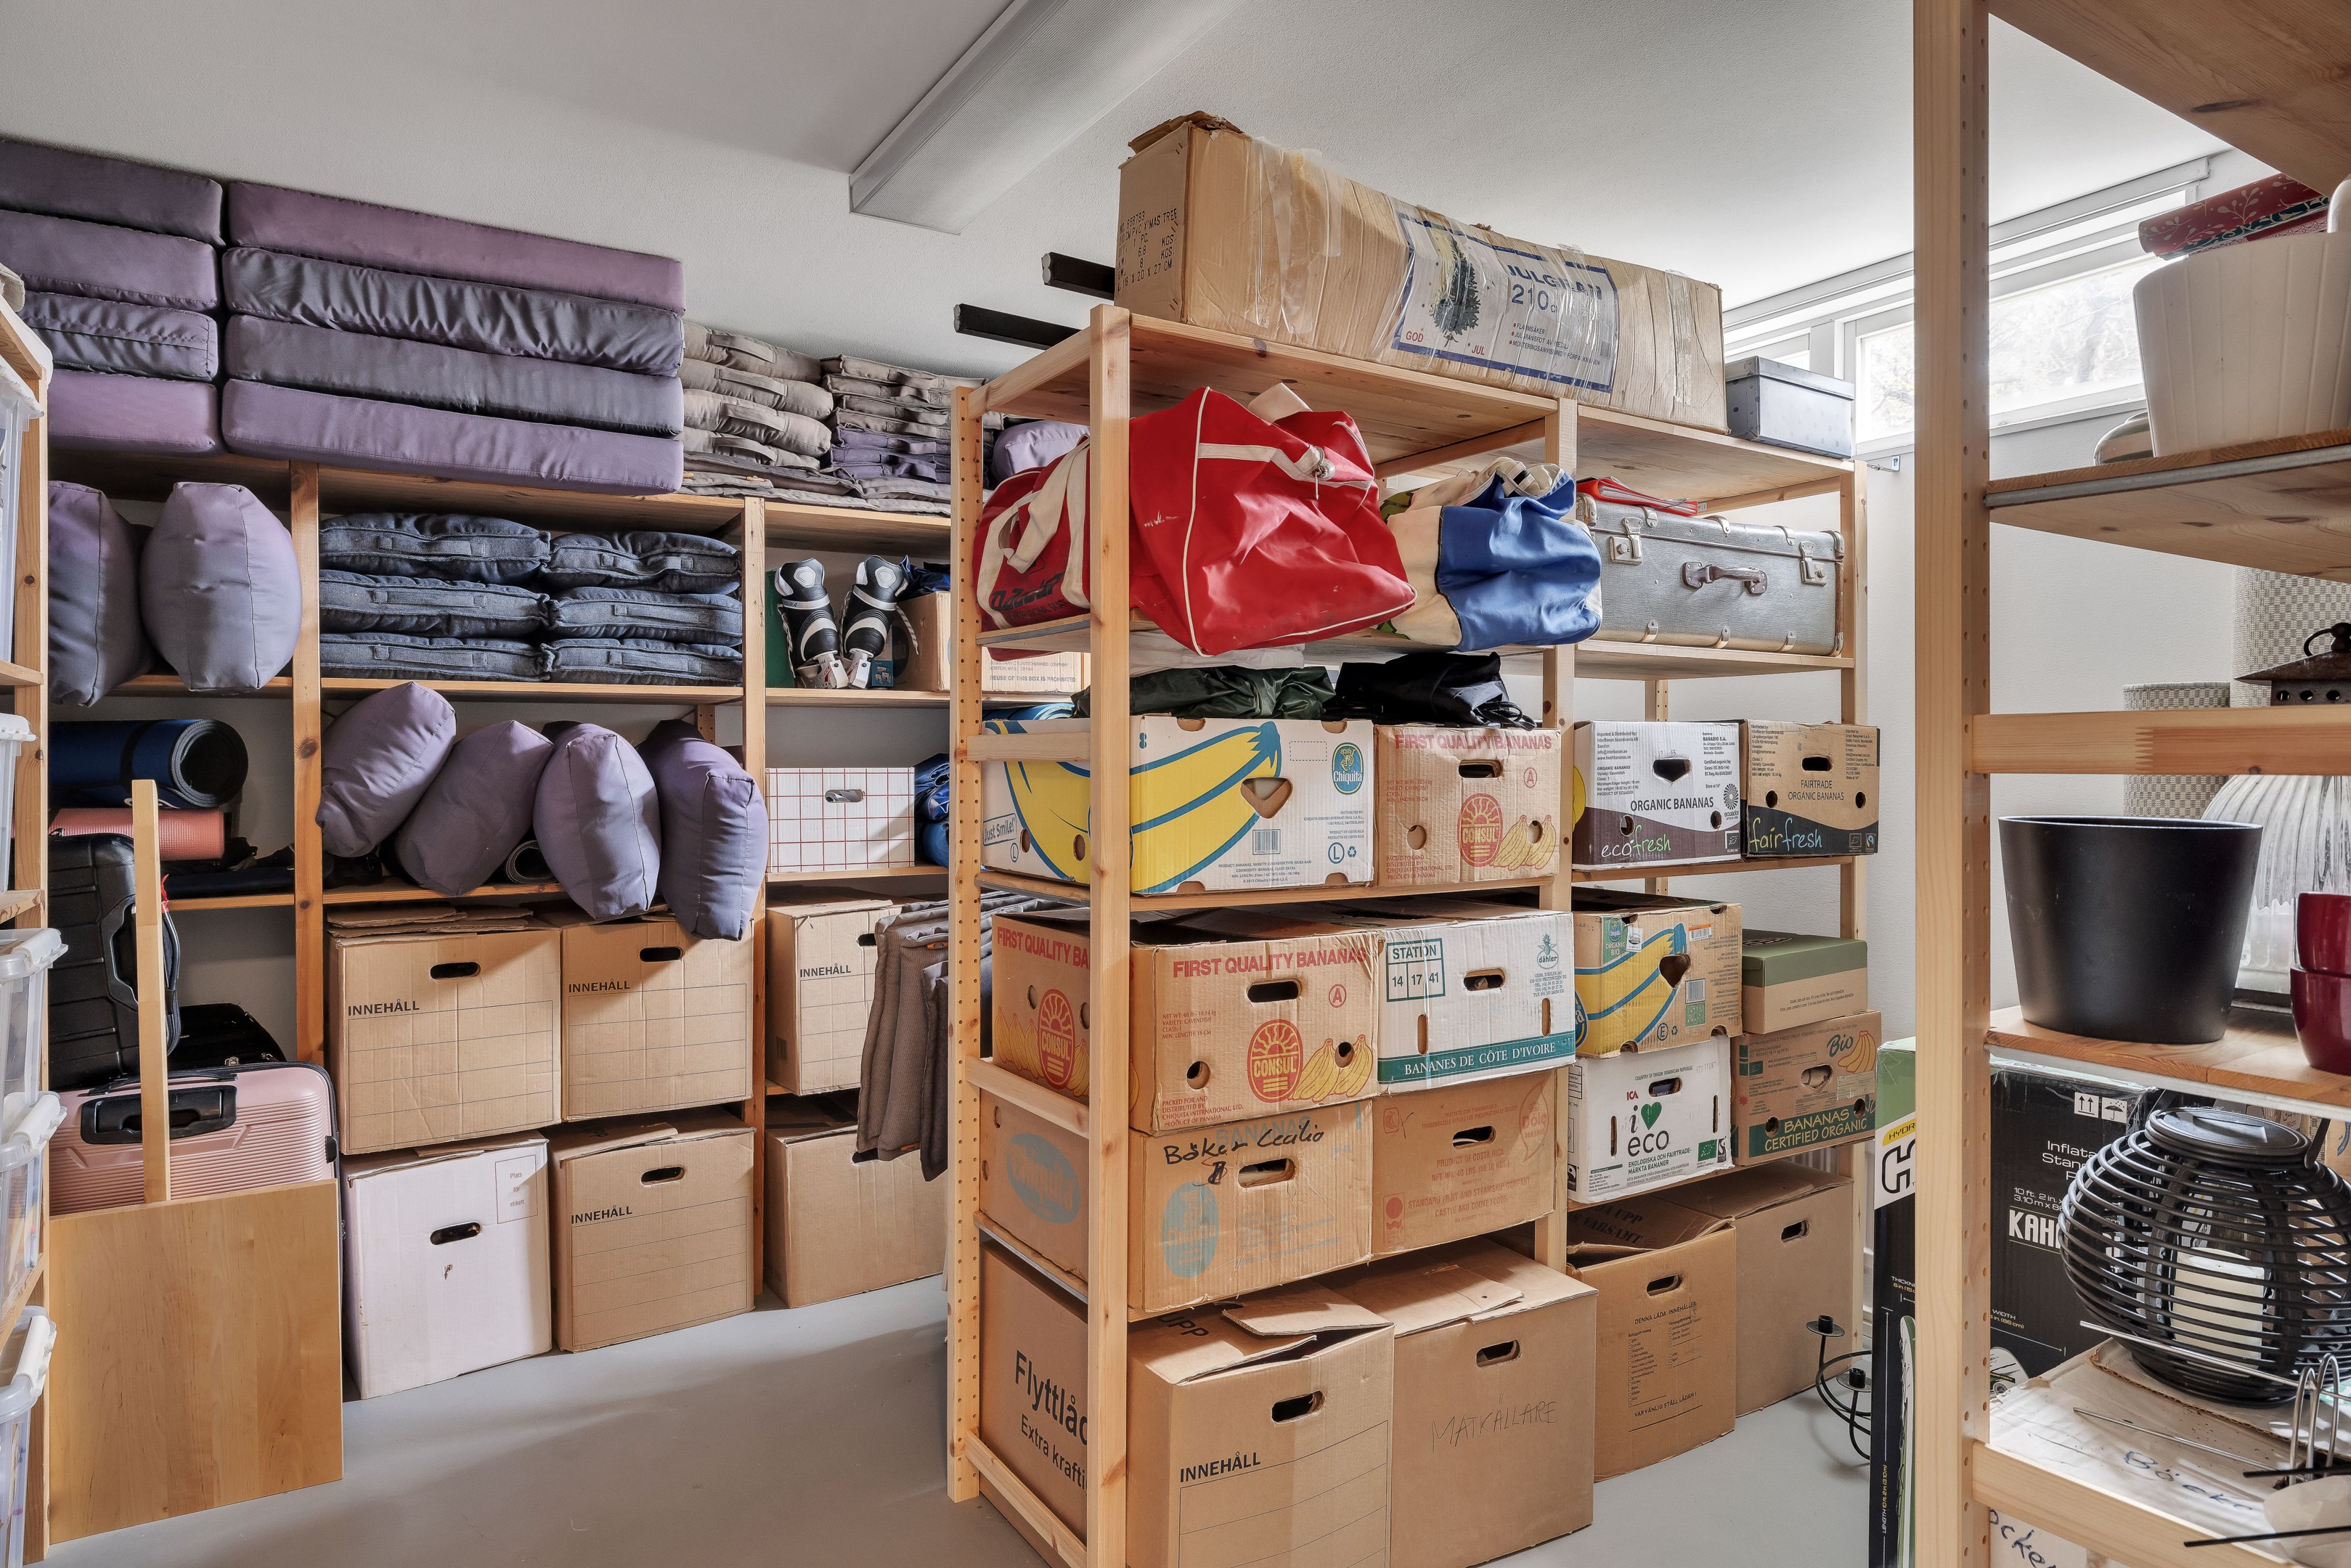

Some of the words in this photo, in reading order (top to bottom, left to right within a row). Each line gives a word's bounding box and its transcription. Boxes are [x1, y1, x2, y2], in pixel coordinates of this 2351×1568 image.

[1163, 208, 1178, 223] TREE
[1138, 270, 1144, 281] 20
[1154, 264, 1161, 274] 27
[1511, 284, 1549, 311] 210
[1406, 331, 1424, 343] GOD
[1472, 345, 1485, 356] JUL
[1395, 734, 1434, 749] FIRST
[1438, 734, 1491, 750] QUALITY
[1495, 735, 1552, 750] BANANAS
[1334, 770, 1362, 785] Chiquita
[1526, 769, 1535, 784] A
[1801, 780, 1833, 789] FAIRTRADE
[1631, 799, 1671, 812] ORGANIC
[1674, 796, 1714, 810] BANANAS
[1788, 791, 1815, 801] ORGANIC
[1817, 791, 1844, 801] BANANAS
[985, 825, 995, 842] Just
[1462, 827, 1498, 844] CONSUL
[997, 926, 1023, 951] FIRST
[1024, 934, 1071, 964] QUALITY
[1392, 944, 1437, 960] STATION
[800, 963, 852, 978] INNEHÅLL
[1173, 958, 1221, 978] FIRST
[1225, 952, 1292, 973] QUALITY
[1297, 947, 1366, 968] BANANAS
[569, 978, 631, 993] INNEHÅLL
[1392, 976, 1403, 987] 14
[1411, 973, 1422, 986] 17
[1429, 971, 1439, 984] 41
[1332, 987, 1342, 1003] A
[348, 998, 420, 1016] INNEHÅLL
[1042, 1031, 1071, 1061] CONSUL
[1827, 1034, 1854, 1058] Bio
[1404, 1056, 1456, 1076] BANANES
[1459, 1055, 1474, 1067] DE
[1480, 1050, 1508, 1064] CÔTE
[1512, 1042, 1556, 1059] D'IVOIRE
[1254, 1057, 1297, 1078] CONSUL
[1162, 1098, 1183, 1107] PACKED
[1627, 1090, 1639, 1101] ICA
[1162, 1105, 1197, 1114] DISTRIBUTED
[1164, 1119, 1191, 1128] PRODUCT
[1199, 1115, 1222, 1124] PANAMA
[1785, 1108, 1850, 1134] BANANAS
[1628, 1130, 1669, 1156] eco
[1765, 1130, 1818, 1152] CERTIFIED
[1822, 1118, 1867, 1138] ORGANIC
[1437, 1156, 1462, 1167] PRODUCT
[1472, 1151, 1491, 1161] COSTA
[1491, 1148, 1504, 1157] RICA
[1629, 1156, 1656, 1167] EKOLOGISKA
[1456, 1169, 1464, 1177] 40
[1629, 1164, 1647, 1175] MÄRKTA
[1647, 1160, 1669, 1169] BANANER
[1409, 1197, 1441, 1209] STANDARD
[1443, 1193, 1458, 1203] FRUIT
[1474, 1183, 1504, 1196] STEAMSHIP
[1506, 1177, 1531, 1190] COMPANY
[2014, 1187, 2024, 1196] 10
[2014, 1194, 2033, 1204] 3.10
[510, 1199, 525, 1207] etikett
[1435, 1206, 1456, 1217] CASTLE
[1458, 1204, 1470, 1212] AND
[1471, 1200, 1489, 1210] COOKE
[571, 1205, 632, 1224] INNEHÅLL
[1614, 1207, 1644, 1225] UPP
[1583, 1217, 1644, 1244] VARSAMT
[1634, 1315, 1653, 1325] DENNA
[1653, 1311, 1666, 1320] LÅDA
[1668, 1301, 1697, 1315] INNEHÅLLER
[1992, 1308, 2016, 1320] WIDTH
[1634, 1409, 1644, 1418] VAR
[1644, 1404, 1663, 1415] VÄNLIG
[1663, 1399, 1679, 1410] STÄLL
[1679, 1393, 1694, 1403] LÅDAN
[1432, 1392, 1557, 1453] MATKÄLLARE
[1021, 1413, 1049, 1458] Extra
[1052, 1444, 1088, 1497] krafti
[1180, 1451, 1261, 1483] INNEHÅLL
